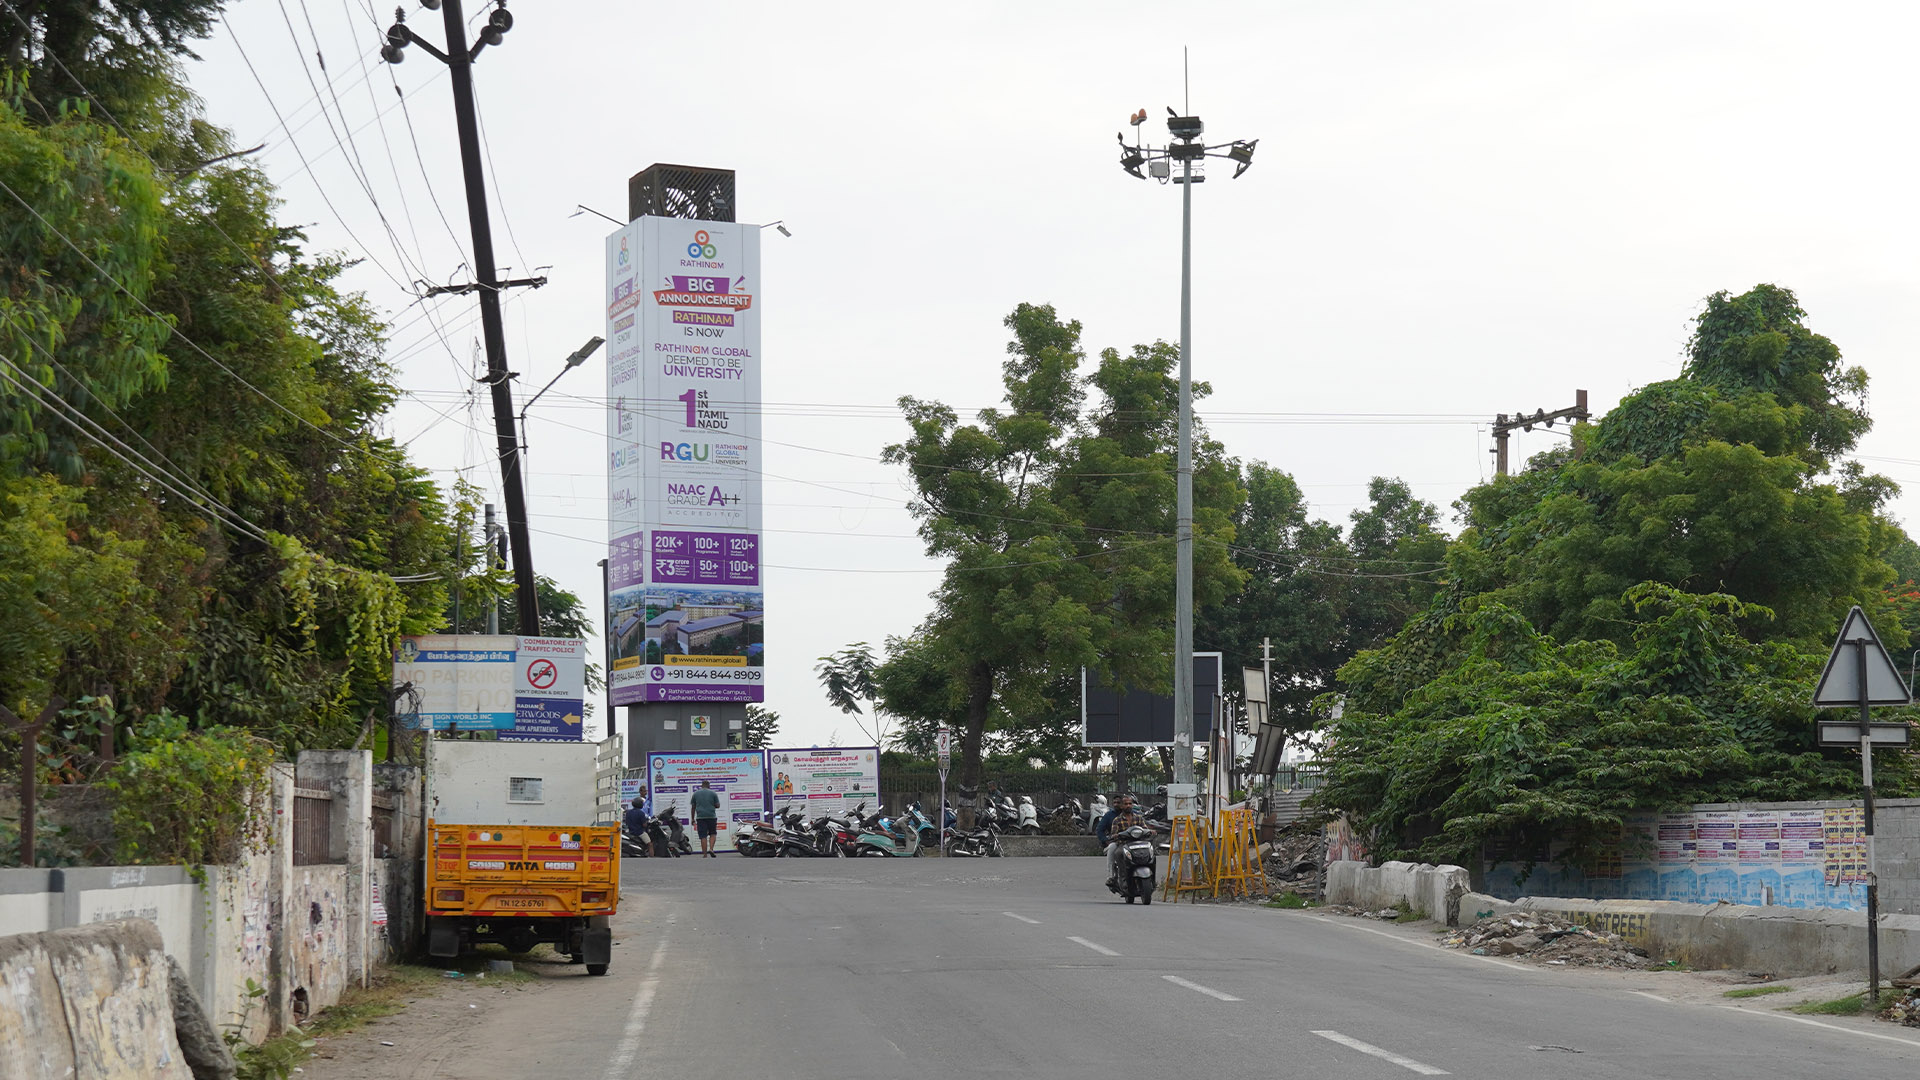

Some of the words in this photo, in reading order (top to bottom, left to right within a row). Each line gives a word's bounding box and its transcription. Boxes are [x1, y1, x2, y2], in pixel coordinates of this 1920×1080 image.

[618, 283, 628, 299] BIG
[688, 278, 715, 292] BIG
[659, 294, 749, 306] ANNOUNCEMENT
[675, 312, 732, 325] RATHINAM
[684, 326, 694, 336] IS
[696, 328, 724, 338] NOW
[712, 347, 752, 357] GLOBAL
[666, 355, 708, 366] DEEMED
[711, 358, 725, 367] TO
[728, 359, 741, 368] BE
[664, 364, 743, 380] UNIVERSITY
[698, 390, 708, 399] st
[679, 389, 696, 427] 1
[698, 400, 708, 409] IN
[698, 410, 729, 420] TAMIL
[698, 420, 728, 429] NADU
[661, 442, 708, 461] RGU
[611, 448, 625, 472] RGU
[668, 483, 705, 495] NAAC
[668, 495, 706, 506] GRADE
[708, 486, 741, 506] A++
[656, 536, 683, 548] 20K+
[694, 538, 719, 549] 100+
[730, 539, 754, 550] 120+
[656, 559, 675, 576] ₹3
[700, 560, 718, 571] 50+
[729, 561, 754, 572] 100+
[427, 652, 488, 661] போக்குவரத்துப்
[490, 652, 510, 661] பிரிவு
[400, 669, 426, 683] NO
[432, 669, 512, 683] PARKING
[668, 670, 684, 679] +91
[687, 670, 708, 679] 844
[710, 670, 732, 679] 844
[734, 671, 761, 680] 8909
[437, 861, 458, 870] STOP
[545, 862, 576, 870] HORN
[1595, 913, 1646, 937] STREET
